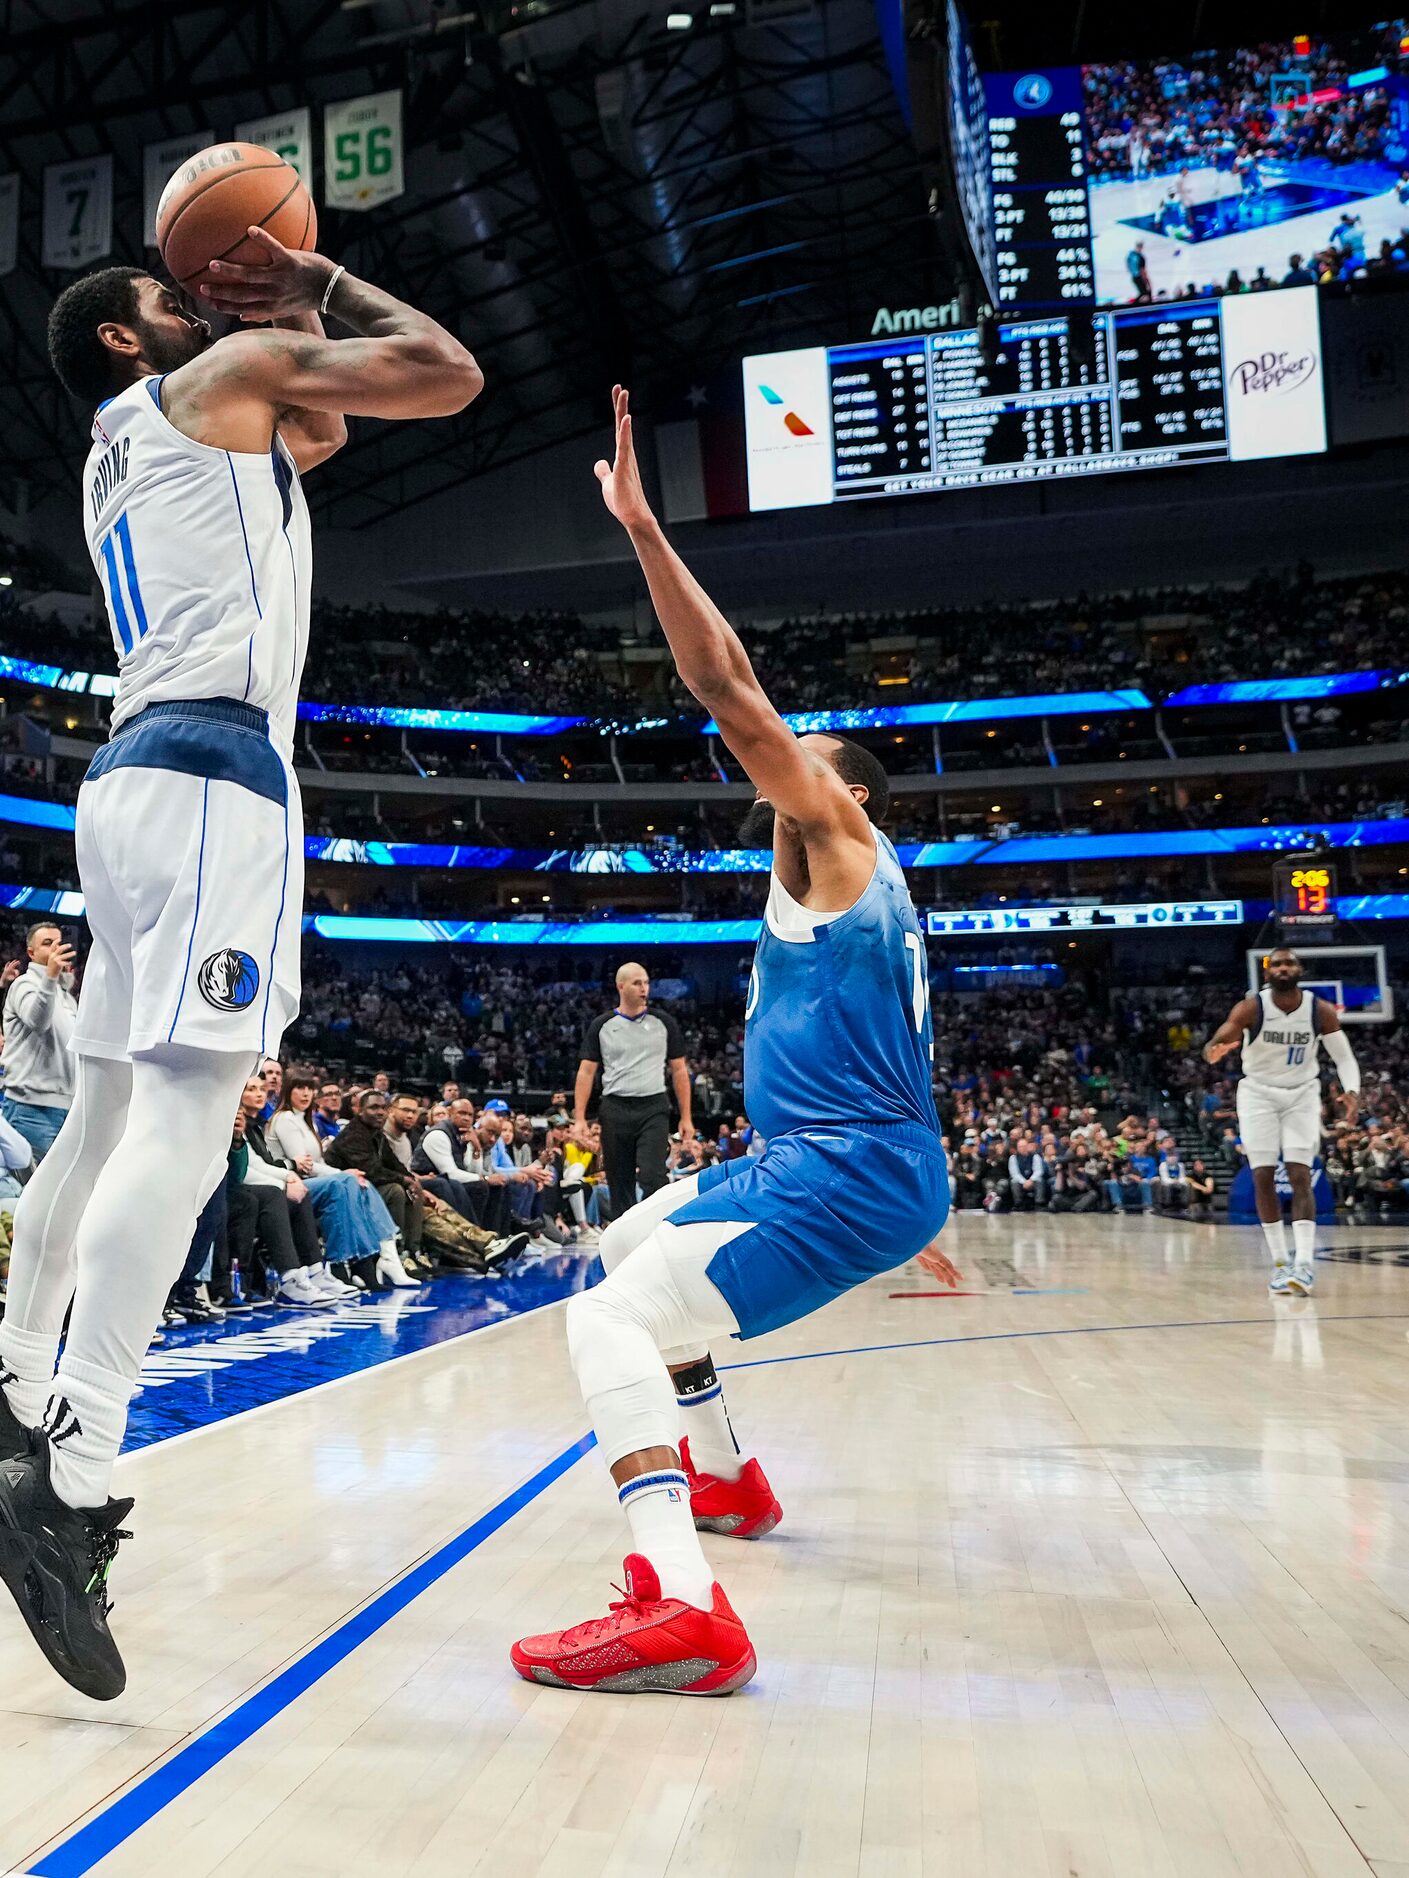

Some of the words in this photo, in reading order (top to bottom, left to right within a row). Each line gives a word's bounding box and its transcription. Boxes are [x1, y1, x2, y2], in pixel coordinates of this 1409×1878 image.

[335, 126, 392, 183] 56
[66, 190, 89, 237] 7
[1235, 356, 1309, 395] Pepper
[1261, 351, 1288, 373] Dr
[90, 436, 131, 523] IRVING
[100, 511, 149, 656] 11
[1297, 886, 1328, 913] 13
[1263, 1031, 1310, 1045] DALLAS
[1286, 1046, 1305, 1065] 10
